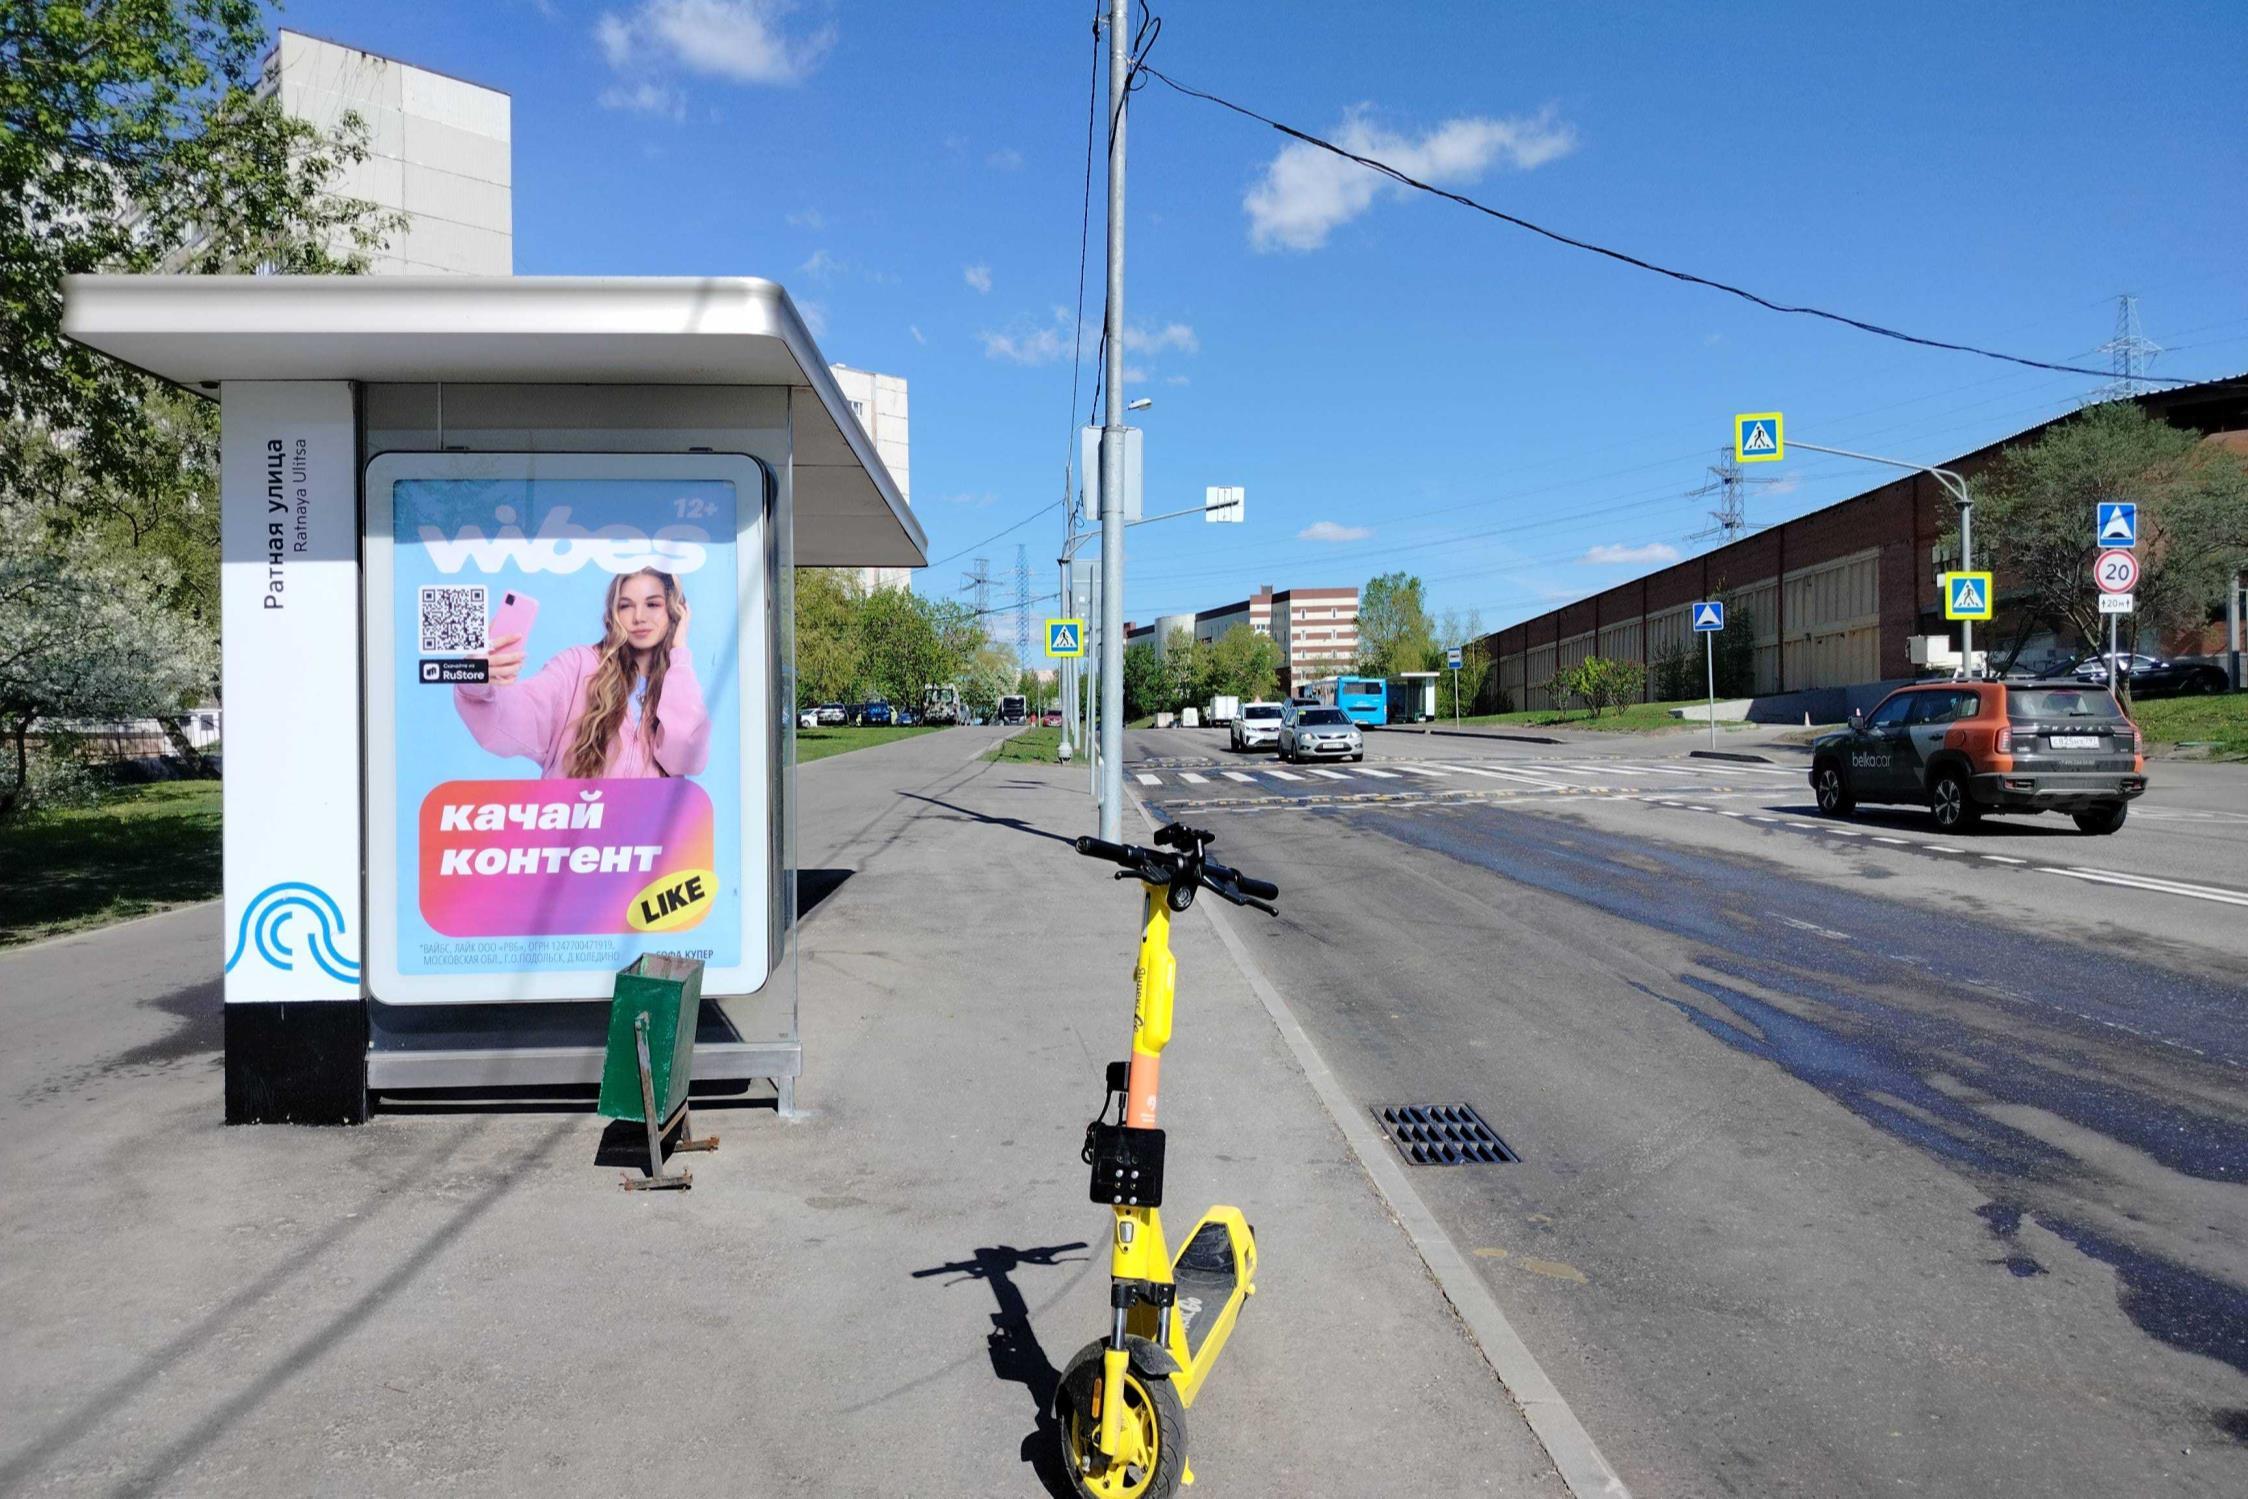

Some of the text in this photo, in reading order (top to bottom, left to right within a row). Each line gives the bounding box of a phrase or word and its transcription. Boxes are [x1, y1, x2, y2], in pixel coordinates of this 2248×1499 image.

[292, 439, 310, 552] Ratnaya Ulitsa
[673, 498, 718, 518] 12+
[264, 439, 288, 609] Ратная улица
[417, 505, 711, 574] wibes
[2105, 563, 2130, 581] 20
[443, 670, 485, 680] RuStore
[1852, 751, 1891, 768] belkacar
[440, 790, 604, 831] качай
[440, 846, 663, 876] контент
[641, 876, 705, 924] LIKE
[528, 941, 550, 951] ОГРН
[685, 949, 714, 960] КУПЕР
[423, 954, 478, 966] МОСКОВСКАЯ
